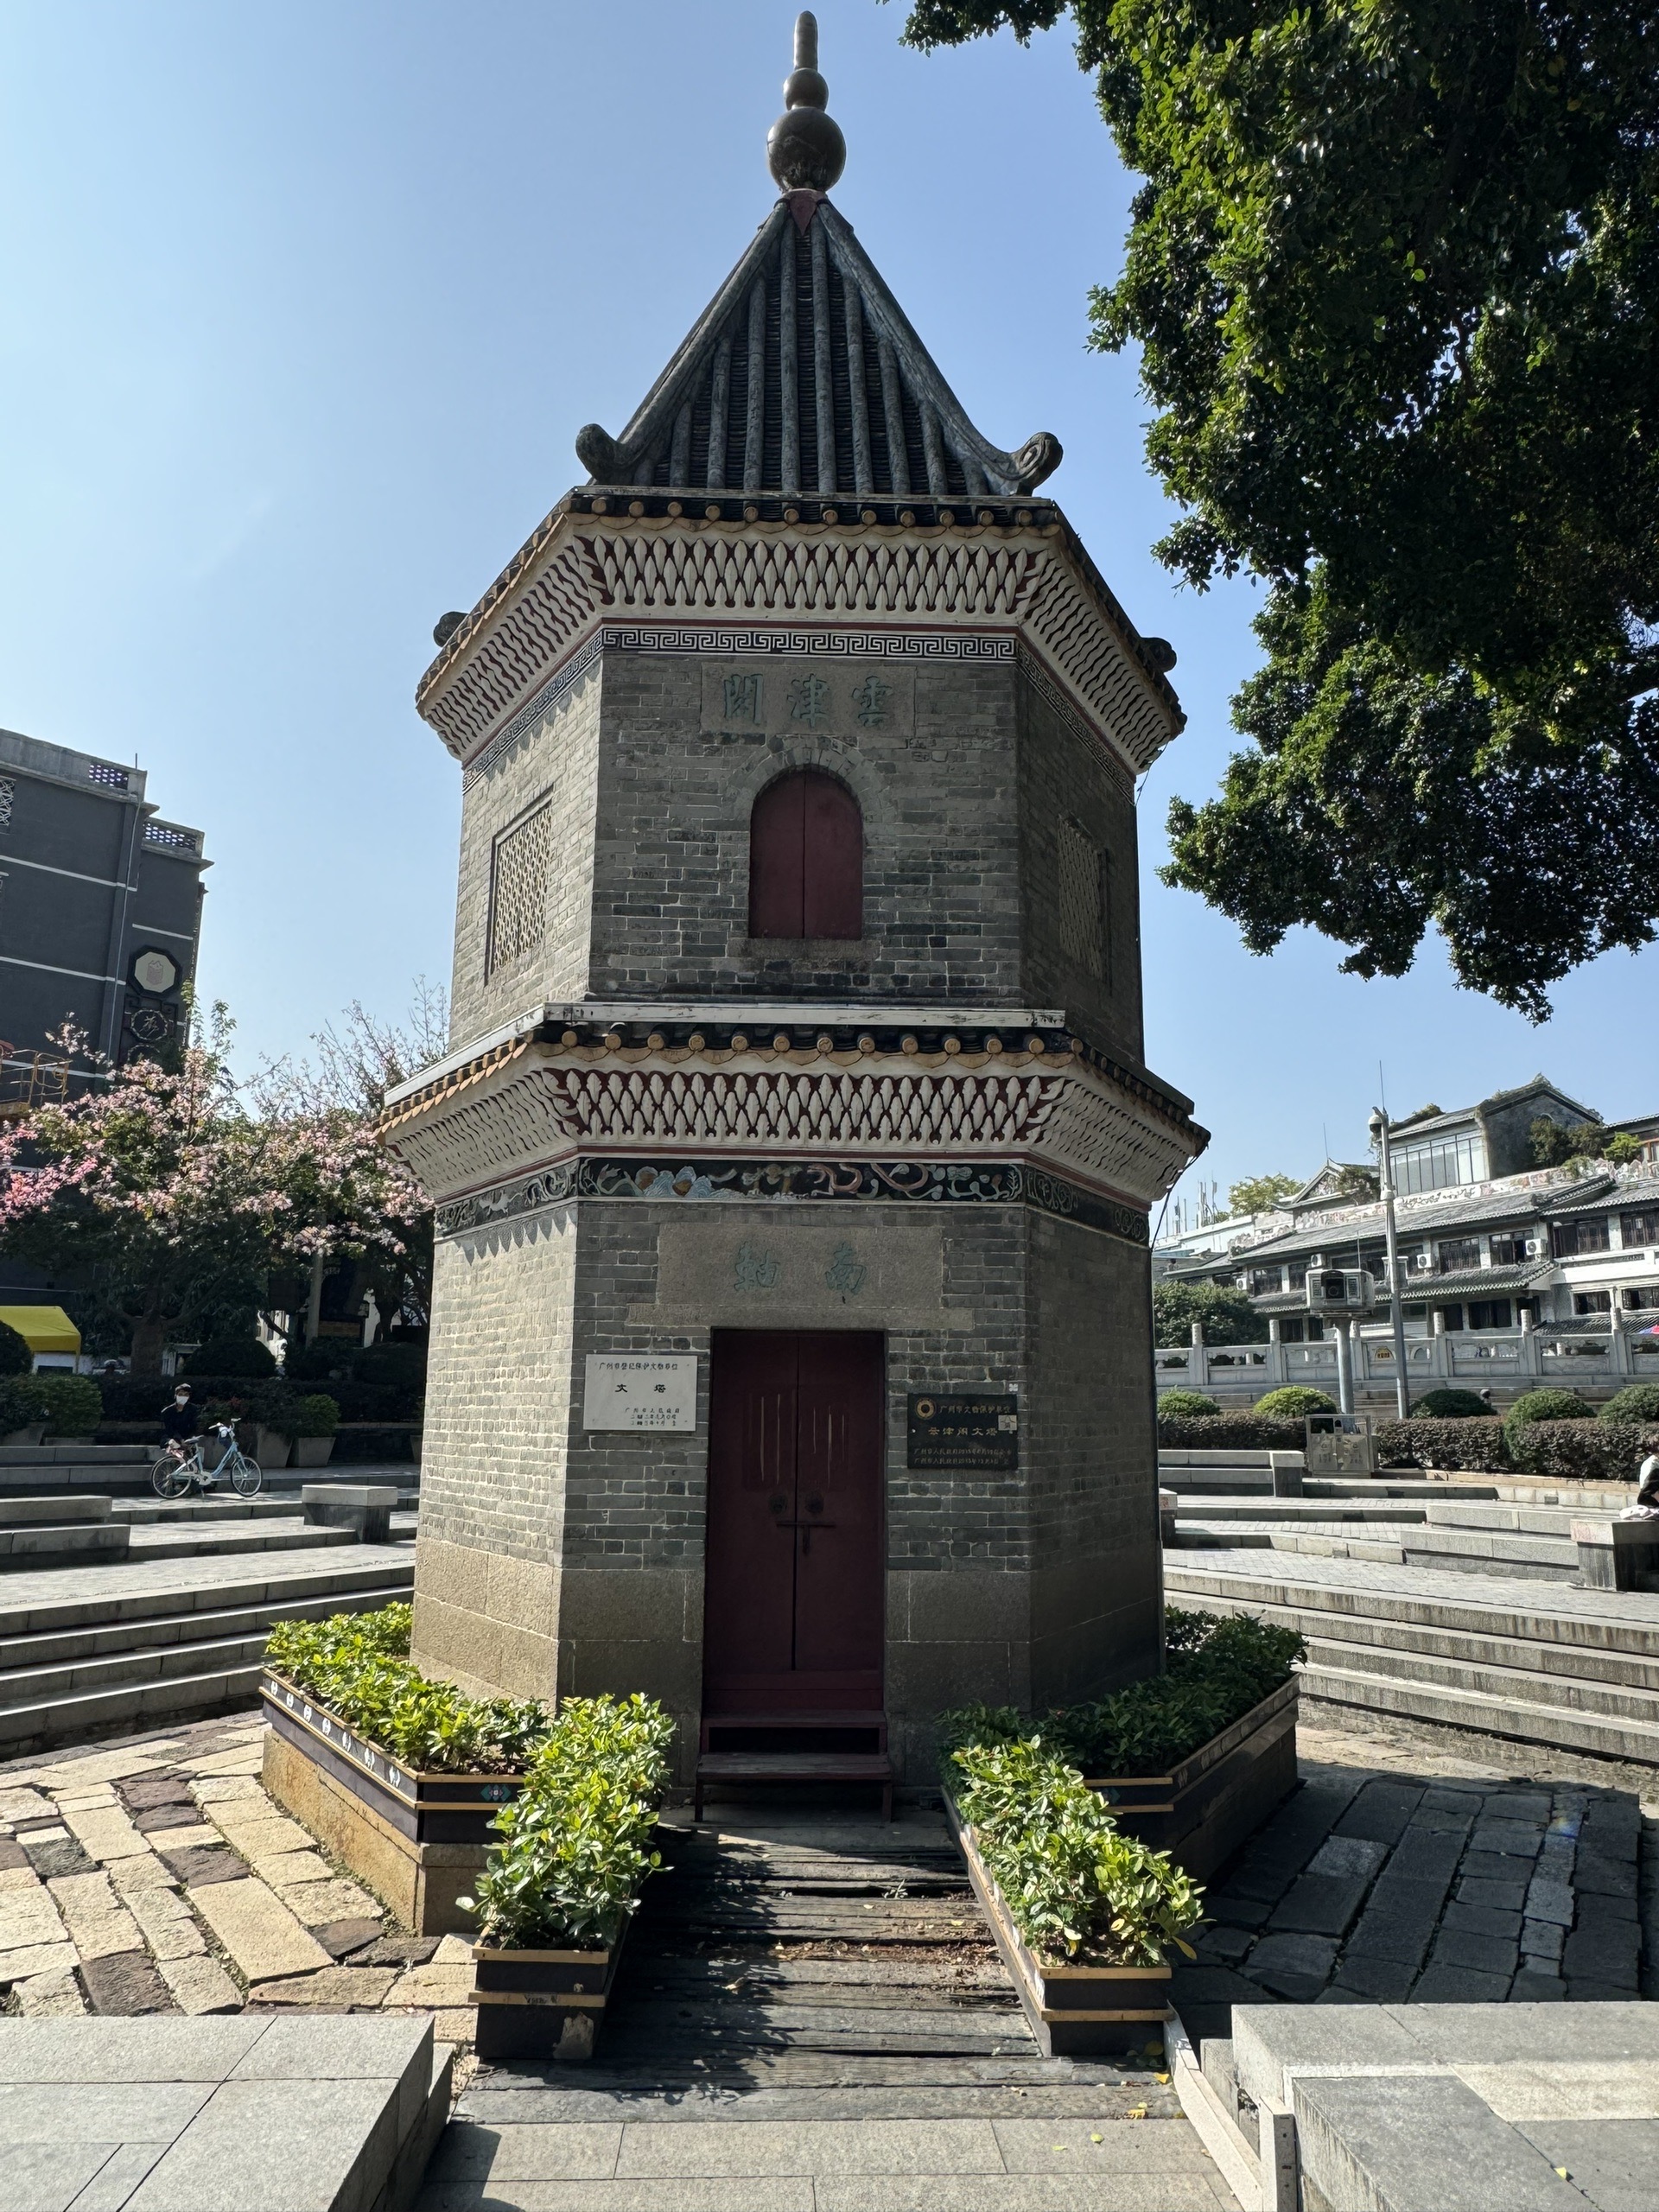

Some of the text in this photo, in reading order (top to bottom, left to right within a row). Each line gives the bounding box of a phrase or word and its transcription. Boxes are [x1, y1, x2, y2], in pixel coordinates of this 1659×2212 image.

[614, 1383, 666, 1393] 文塔
[928, 1427, 998, 1436] 云津阁文塔
